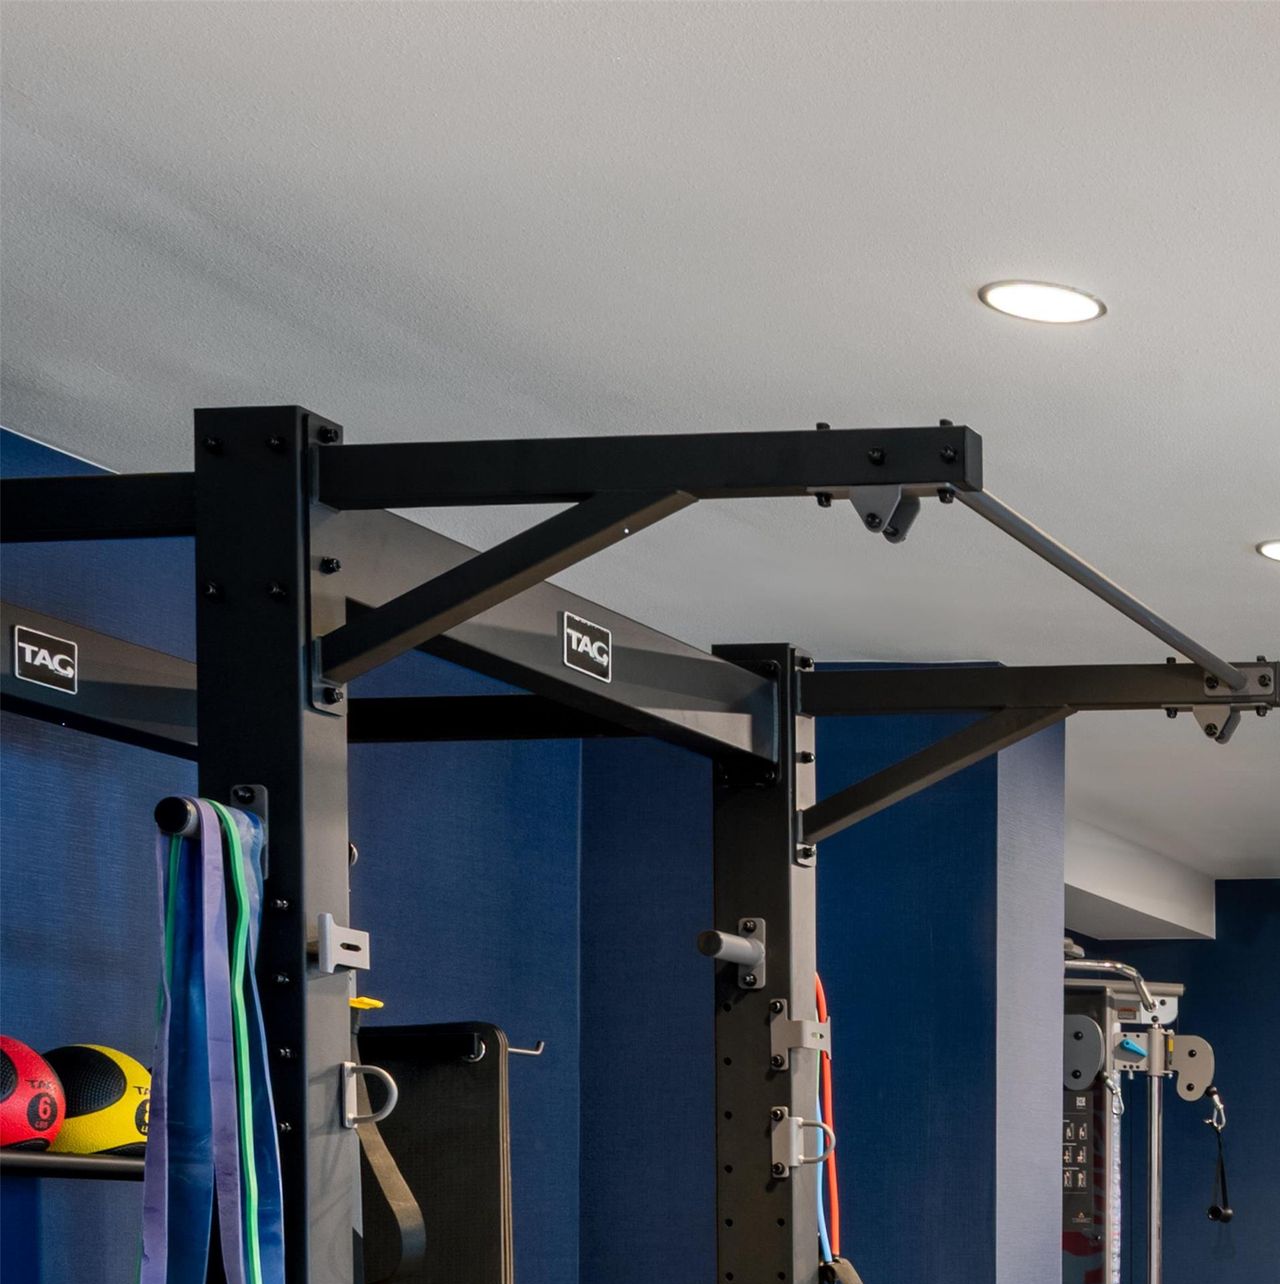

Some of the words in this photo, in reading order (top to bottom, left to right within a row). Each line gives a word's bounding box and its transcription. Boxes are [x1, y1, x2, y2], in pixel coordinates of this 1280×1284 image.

[18, 641, 75, 679] TAG
[566, 628, 609, 668] TAG
[37, 1096, 52, 1120] 6
